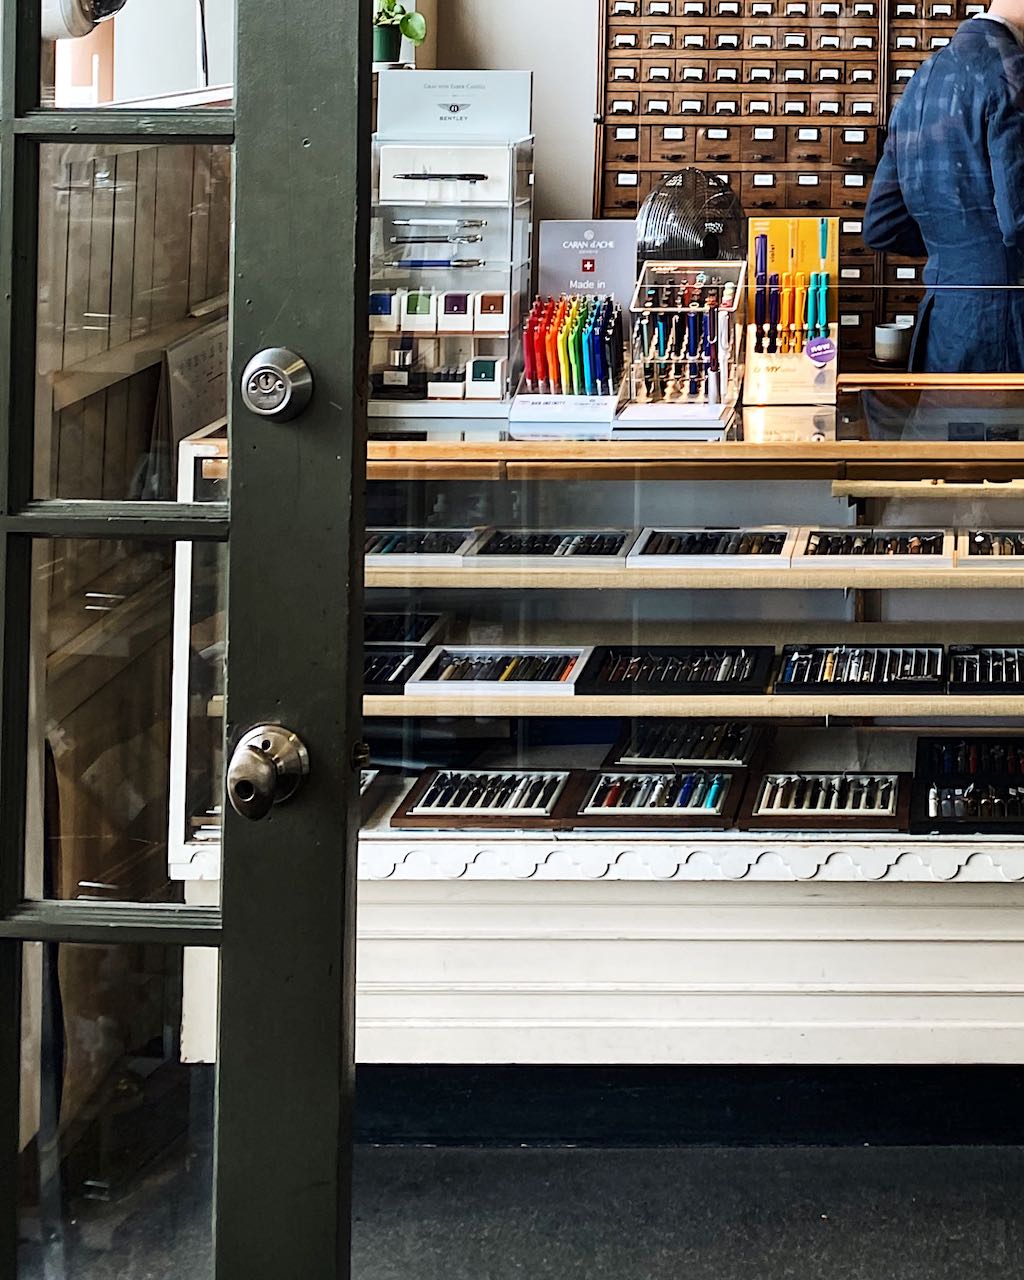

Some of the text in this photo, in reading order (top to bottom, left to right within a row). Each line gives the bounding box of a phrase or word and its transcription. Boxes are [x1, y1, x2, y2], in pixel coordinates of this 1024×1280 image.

[562, 240, 589, 249] CARAN
[569, 279, 606, 289] Made in
